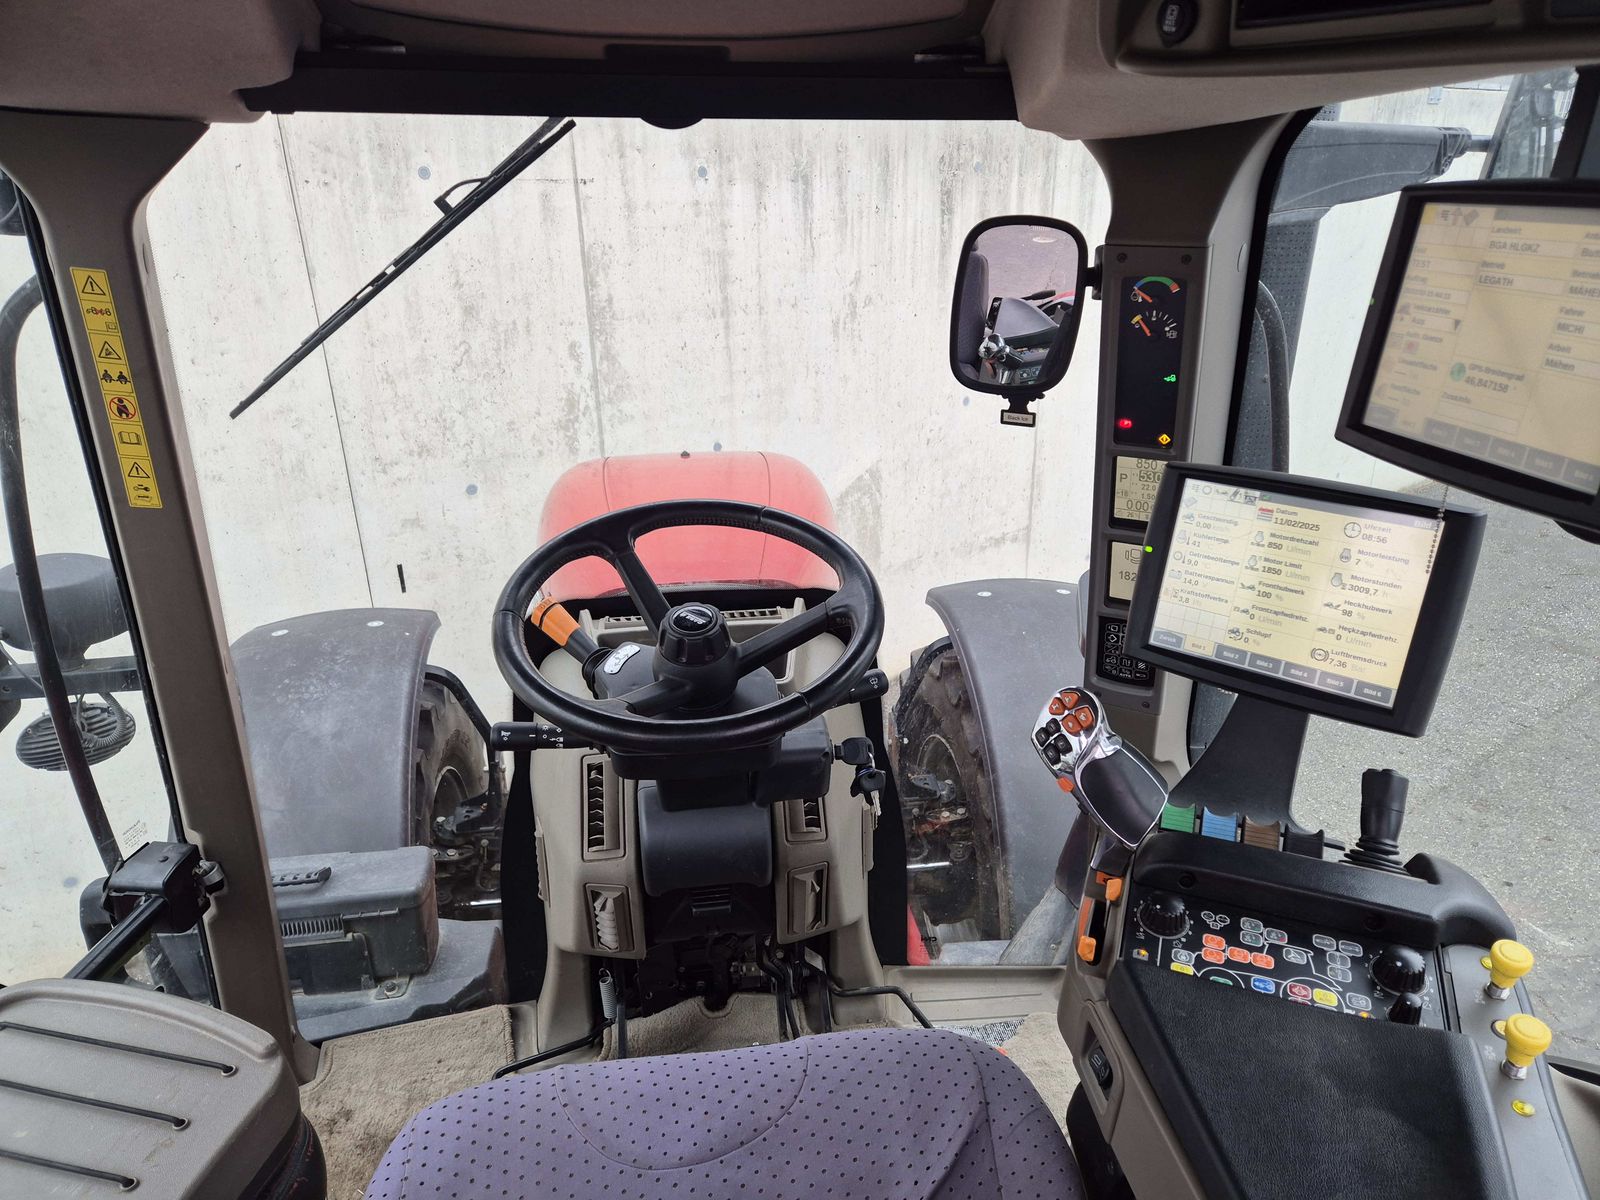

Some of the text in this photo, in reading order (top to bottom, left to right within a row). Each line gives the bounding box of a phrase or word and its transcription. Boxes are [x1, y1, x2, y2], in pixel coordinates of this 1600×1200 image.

[1479, 275, 1514, 287] LEGATH
[1136, 459, 1157, 470] 850
[1120, 473, 1128, 482] P
[1276, 508, 1298, 516] Datum
[1273, 517, 1320, 532] 11/02/2025
[1364, 523, 1392, 533] Uhrzeit
[1362, 534, 1388, 544] 08:56
[1267, 541, 1283, 550] 850
[1263, 557, 1283, 566] Motor
[1262, 566, 1282, 575] 1850
[1351, 574, 1402, 590] Motorstunden
[1258, 581, 1304, 595] Fronthubwerk
[1256, 590, 1272, 599] 100
[1344, 600, 1393, 615] Heckhubwerk
[1246, 628, 1272, 638] Schlupf
[1331, 650, 1387, 667] Luftbremsdruck
